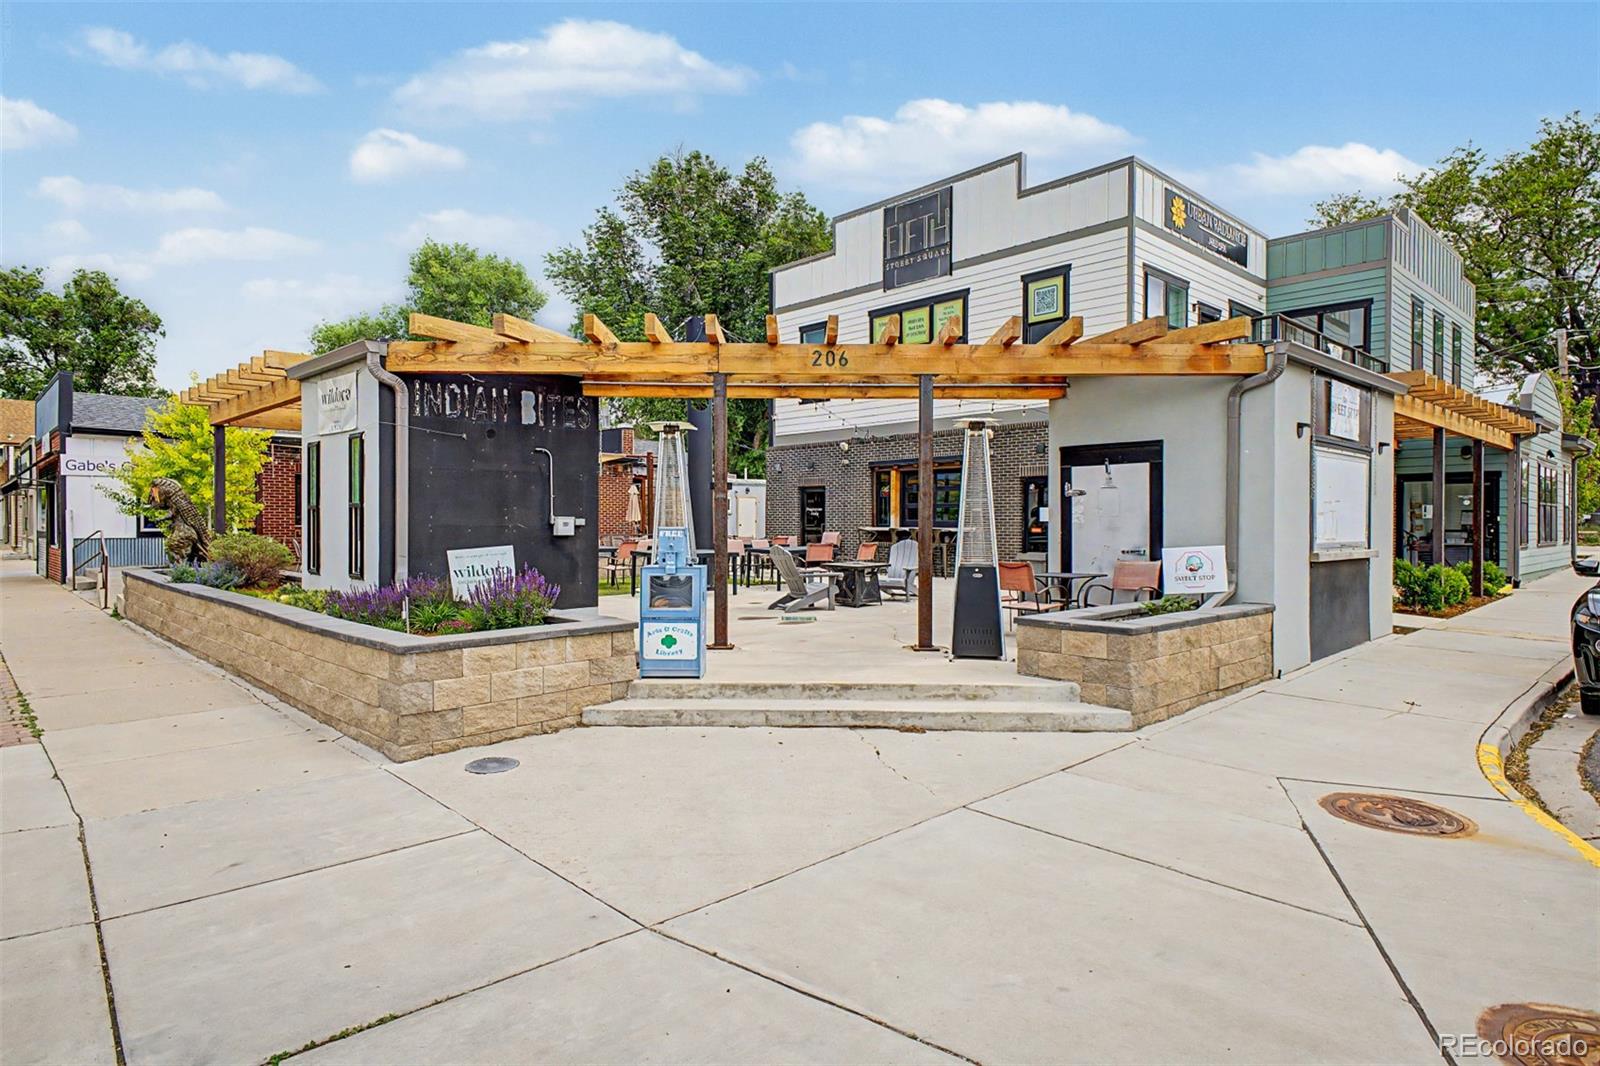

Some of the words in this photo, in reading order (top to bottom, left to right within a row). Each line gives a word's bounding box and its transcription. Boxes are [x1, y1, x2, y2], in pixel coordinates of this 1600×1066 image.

[886, 207, 950, 259] FIFTH
[1187, 201, 1213, 229] URBAN
[1213, 215, 1247, 248] RADIANCE
[886, 257, 914, 271] STREET
[916, 246, 951, 263] SQUARE
[812, 350, 849, 367] 206
[413, 378, 509, 423] INDIAN
[520, 389, 591, 430] BITES
[65, 459, 116, 472] Gabe's
[655, 648, 683, 656] Library
